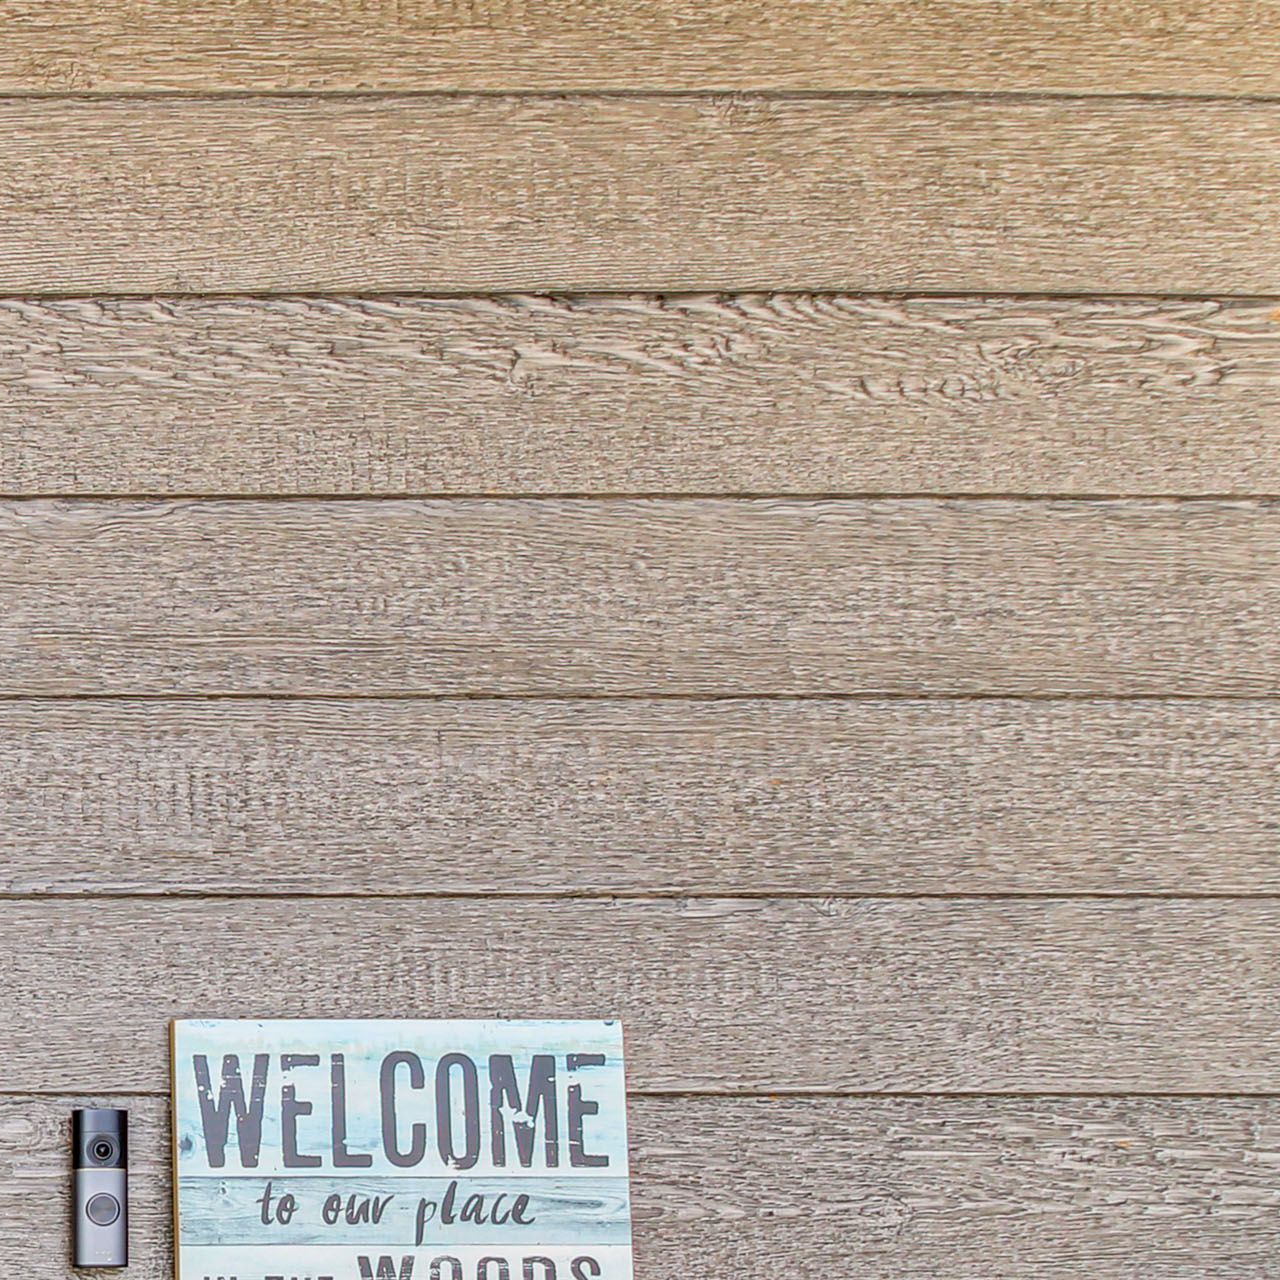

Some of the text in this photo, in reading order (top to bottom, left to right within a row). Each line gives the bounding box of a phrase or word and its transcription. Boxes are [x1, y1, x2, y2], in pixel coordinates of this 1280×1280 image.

[192, 1050, 610, 1170] WELCOME
[256, 1180, 537, 1247] to our place
